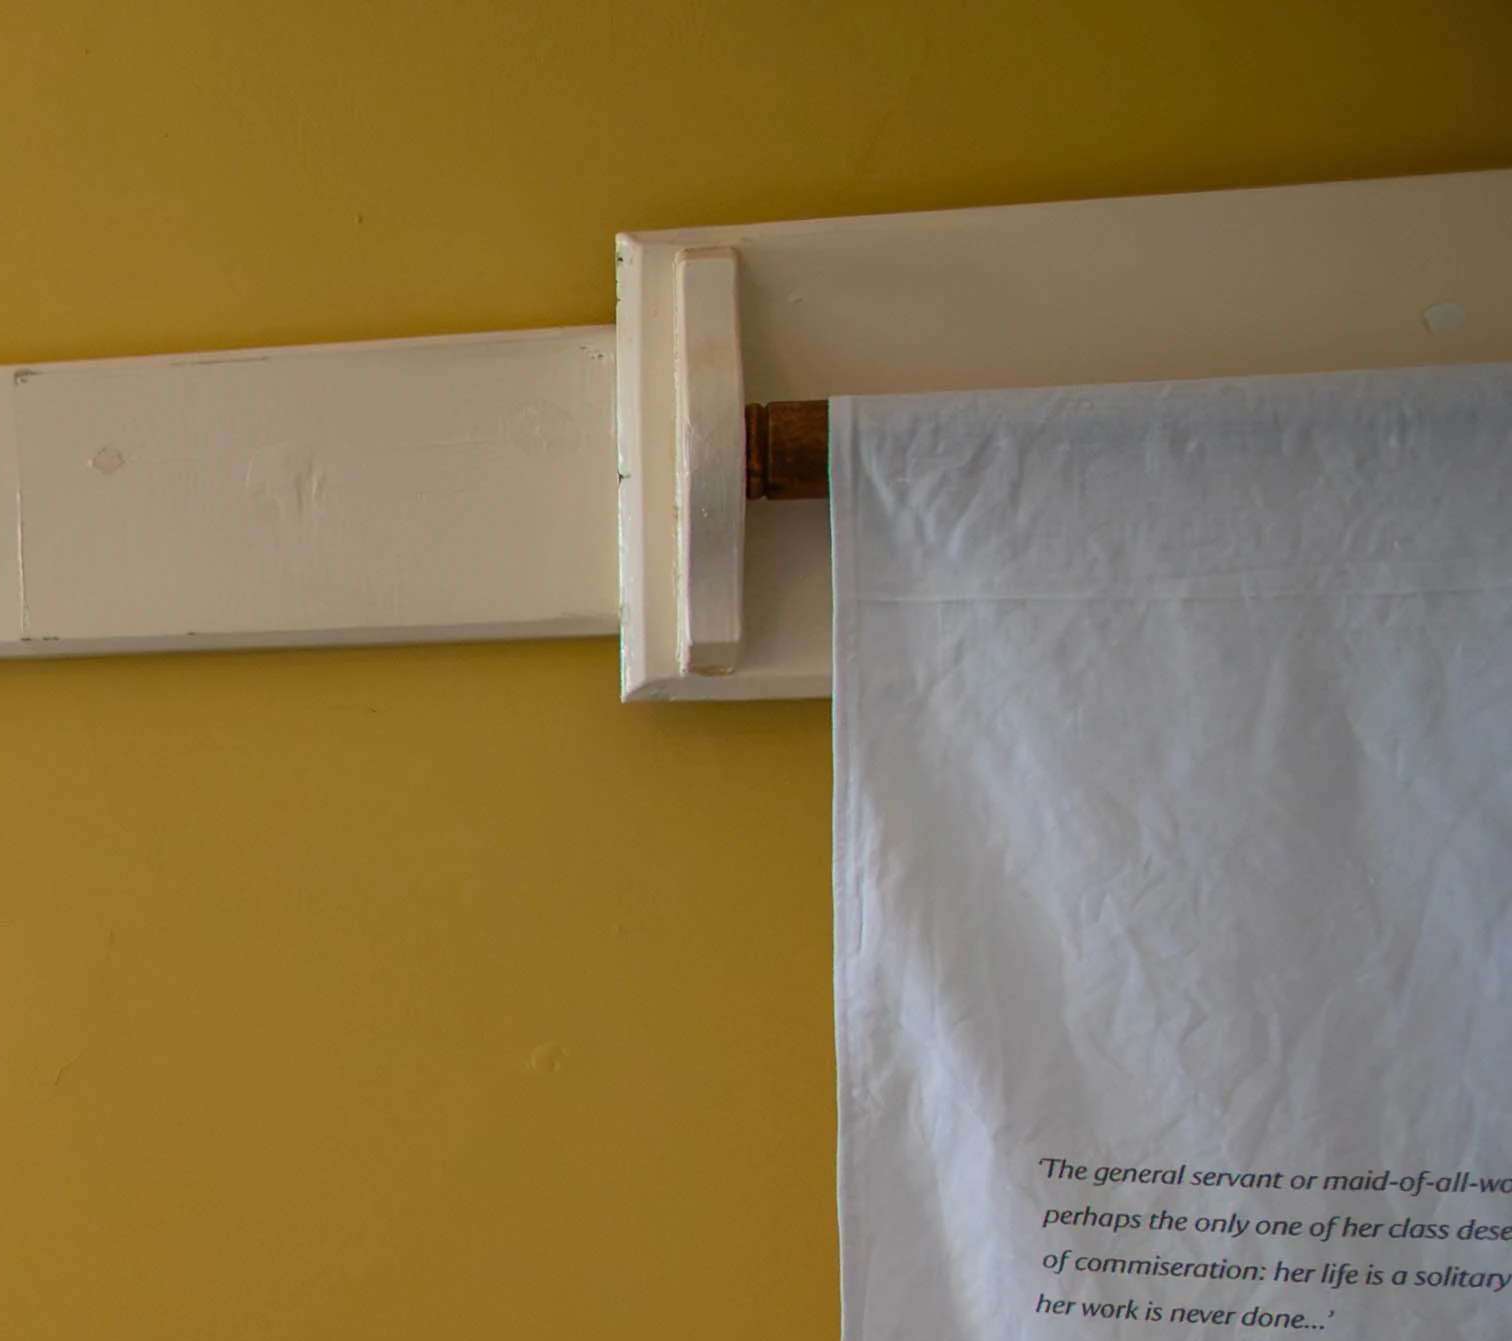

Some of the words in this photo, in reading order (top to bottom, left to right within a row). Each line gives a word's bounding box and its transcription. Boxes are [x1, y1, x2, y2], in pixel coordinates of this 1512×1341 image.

[1093, 1164, 1186, 1186] general
[1190, 1170, 1285, 1190] servant
[1290, 1174, 1318, 1190] or
[1042, 1206, 1142, 1233] perhaps
[1149, 1210, 1188, 1231] the
[1195, 1212, 1250, 1238] only
[1255, 1219, 1303, 1237] one
[1309, 1216, 1341, 1242] of
[1342, 1216, 1384, 1238] her
[1388, 1217, 1450, 1240] class
[1457, 1219, 1512, 1241] dese
[1042, 1250, 1072, 1275] of
[1075, 1255, 1267, 1281] commiseration:
[1273, 1261, 1316, 1283] her
[1321, 1262, 1359, 1289] life
[1365, 1264, 1384, 1286] is
[1391, 1269, 1408, 1286] a
[1414, 1266, 1512, 1292] solitary
[1035, 1293, 1076, 1316] her
[1082, 1299, 1139, 1320] work
[1145, 1301, 1163, 1322] is
[1170, 1307, 1236, 1325] never
